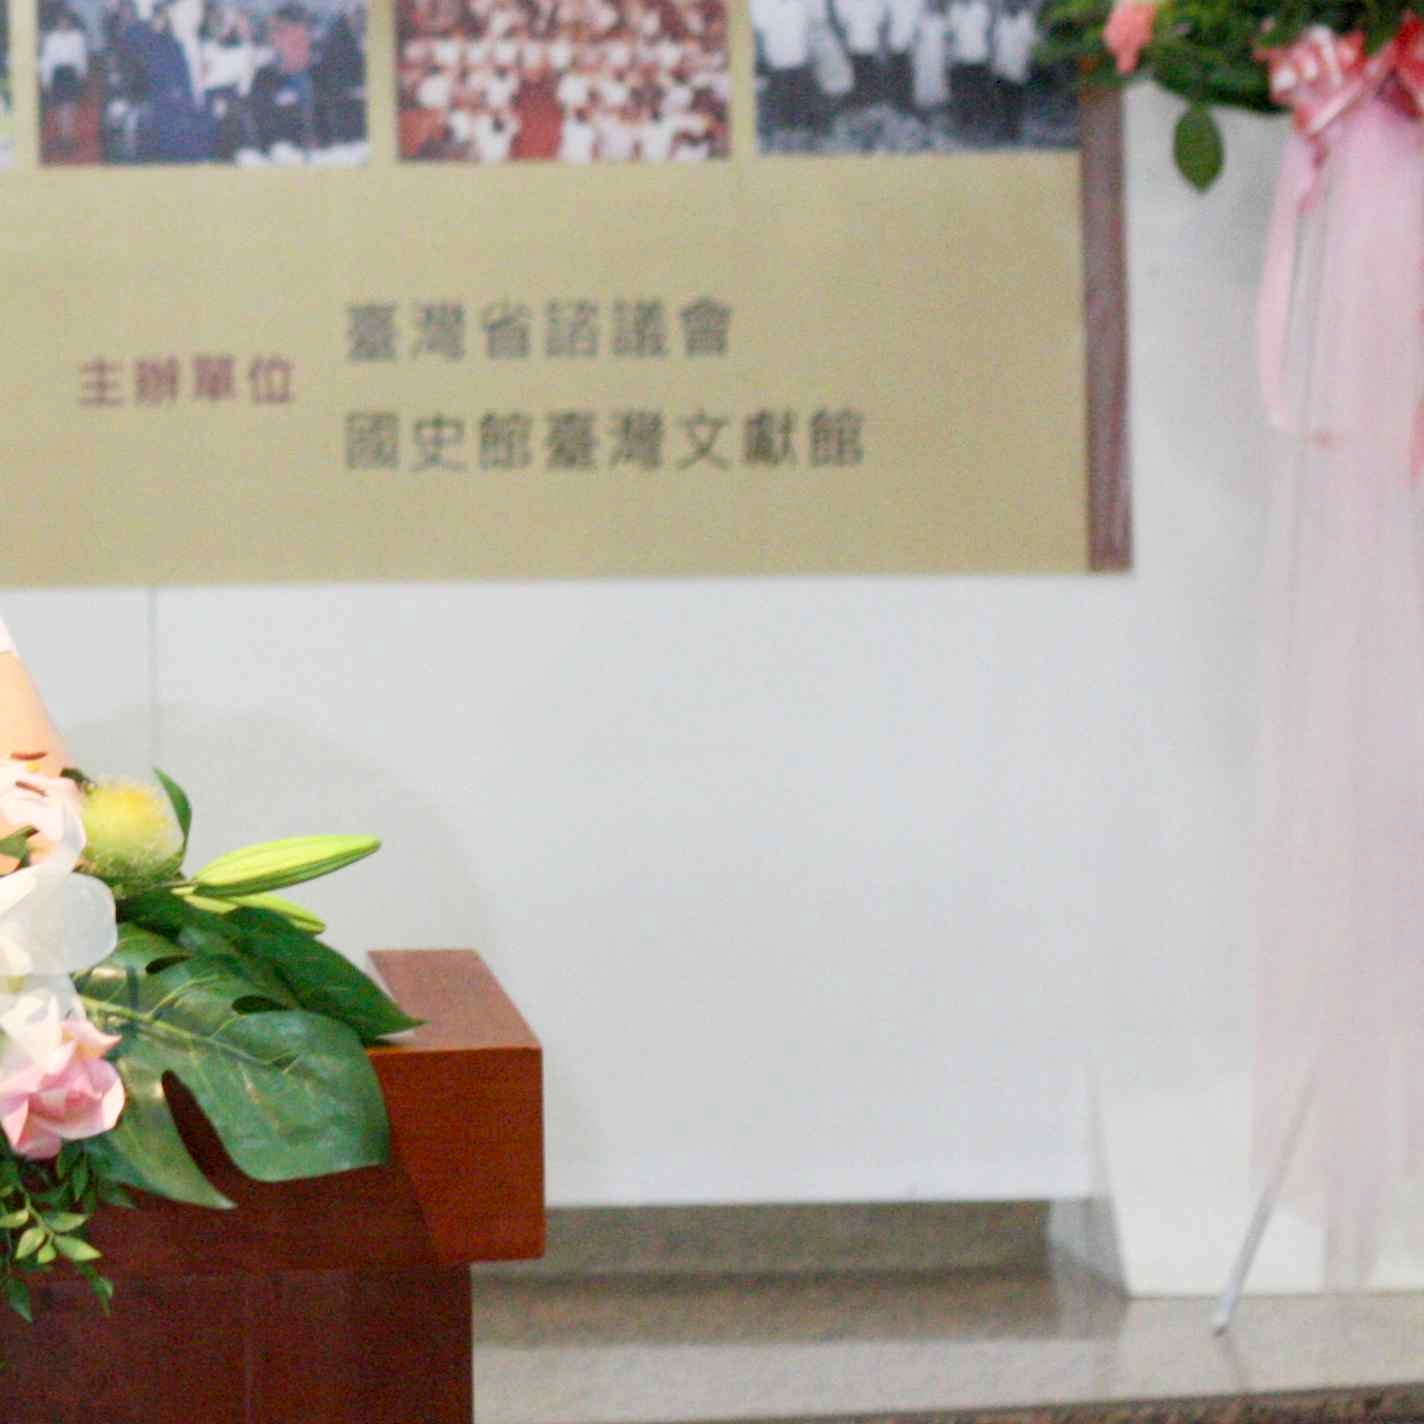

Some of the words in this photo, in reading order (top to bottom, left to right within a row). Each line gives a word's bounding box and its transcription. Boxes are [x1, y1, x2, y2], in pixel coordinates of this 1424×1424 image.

[347, 298, 733, 362] 臺灣省諮議會
[78, 355, 295, 407] 主辦單位
[345, 408, 865, 472] 國史館臺灣文獻館
